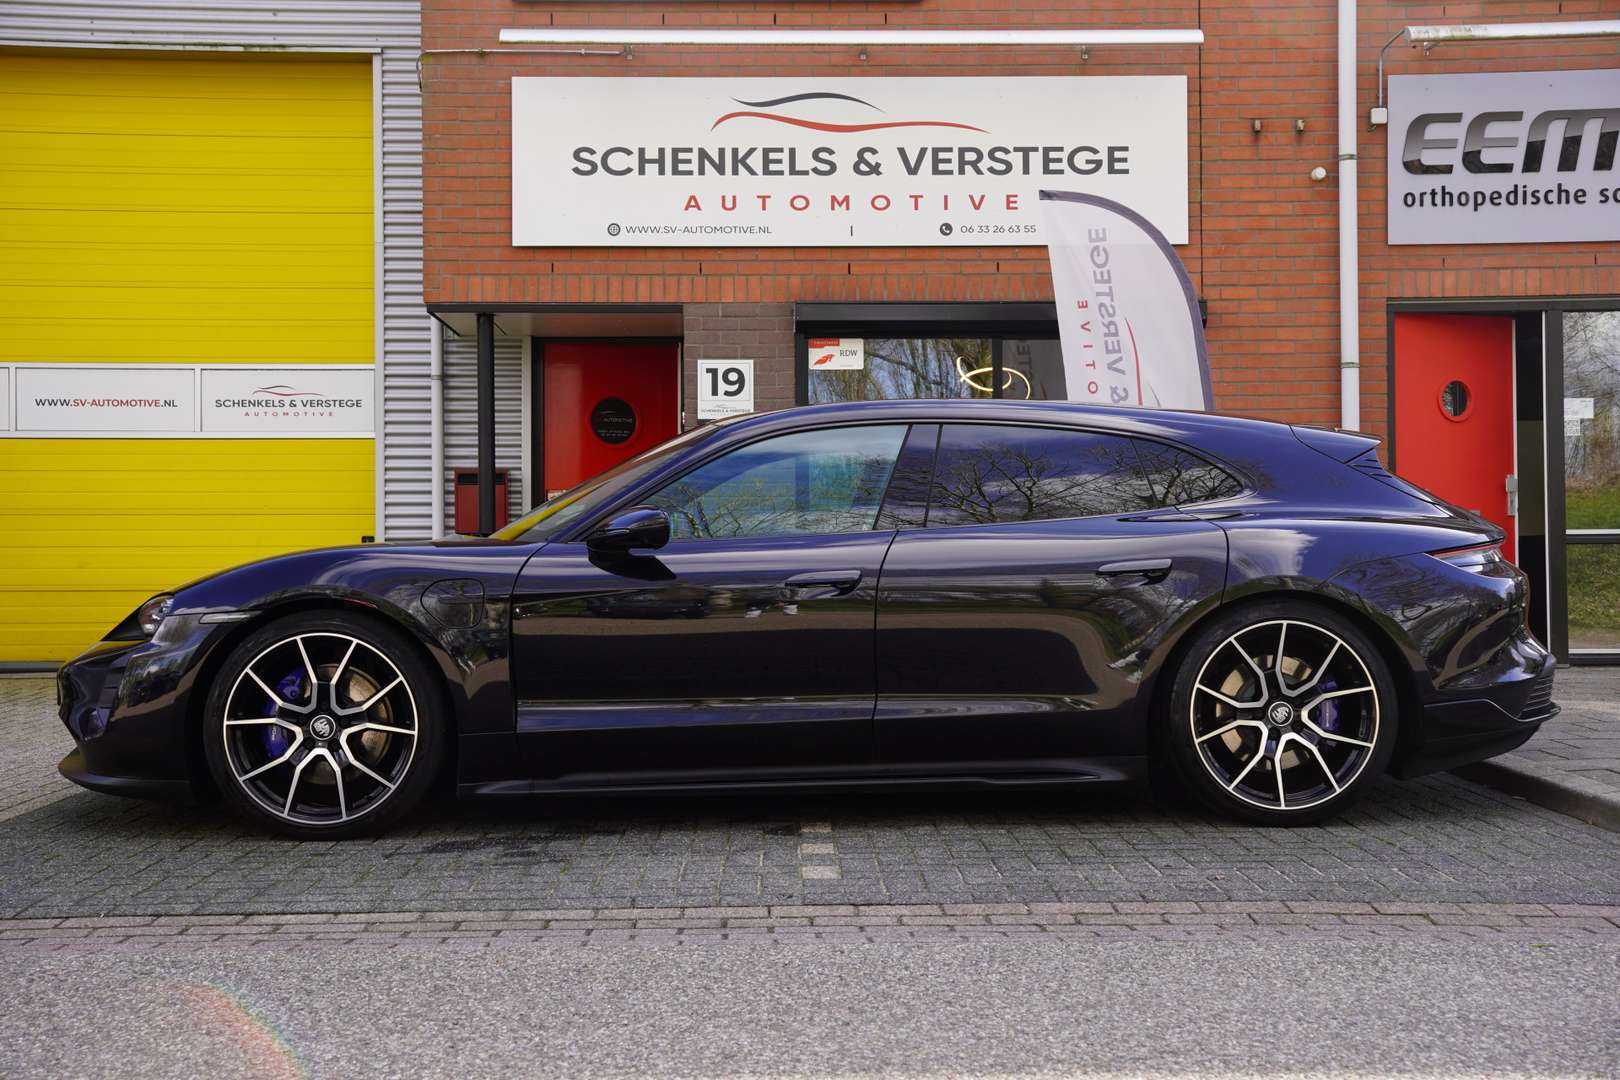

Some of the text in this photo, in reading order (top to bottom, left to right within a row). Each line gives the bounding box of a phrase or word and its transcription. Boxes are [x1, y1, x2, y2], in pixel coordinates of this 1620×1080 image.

[571, 145, 1130, 176] SCHENKELS & VERSTEGE
[684, 194, 1019, 211] AUTOMOTIVE
[1403, 183, 1587, 212] orthopedische
[625, 225, 772, 235] WWW.SV-AUTOMOTIVE.NL
[960, 224, 1037, 234] 06 33 26 63 55
[839, 349, 858, 357] RDW
[706, 367, 746, 397] 19
[35, 398, 178, 408] WWW.SV-AUTOMOTIVE.NL
[215, 399, 363, 408] SCHENKELS & VERSTEGE
